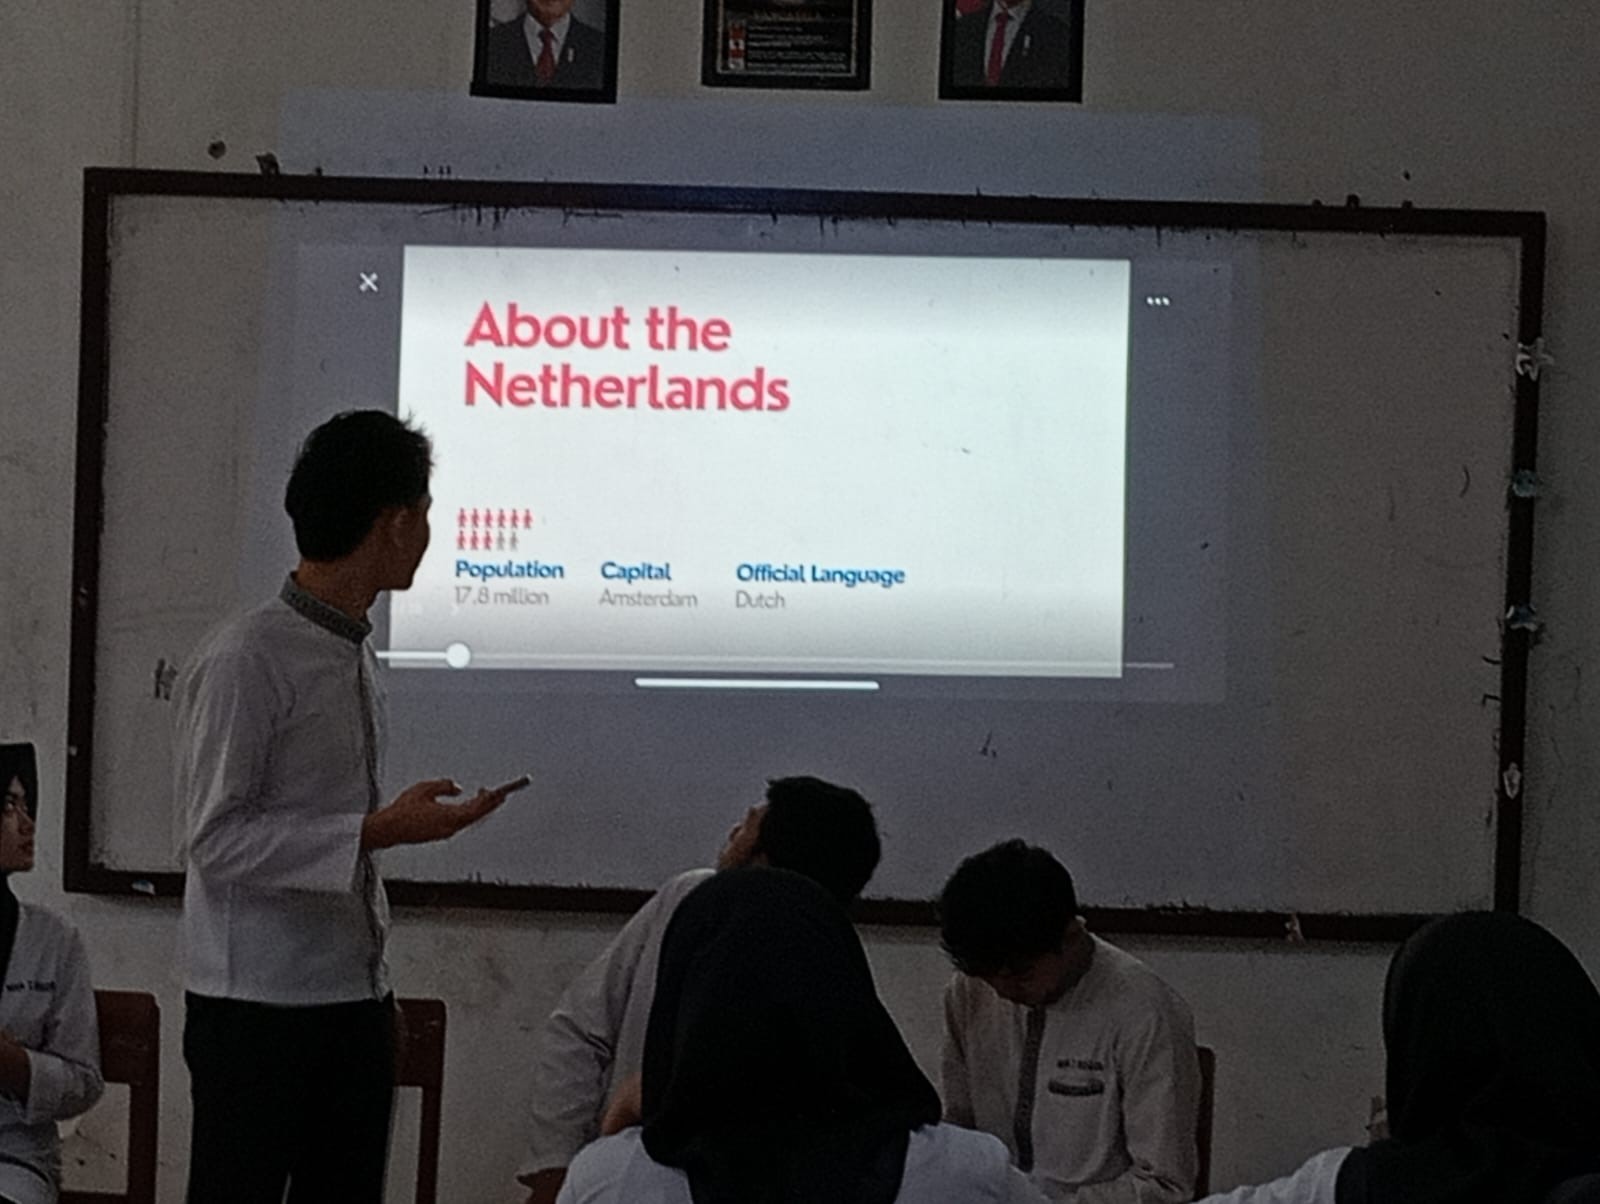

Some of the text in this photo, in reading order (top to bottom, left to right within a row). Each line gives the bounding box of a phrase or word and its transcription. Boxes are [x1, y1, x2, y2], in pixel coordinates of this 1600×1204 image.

[465, 301, 731, 352] About the
[464, 360, 790, 412] Netherlands
[455, 559, 565, 582] Population
[600, 561, 671, 584] Capital
[736, 562, 906, 588] Official Language
[454, 585, 550, 605] 17.8 million
[599, 588, 699, 608] Amsterdam
[736, 590, 786, 609] Dutch
